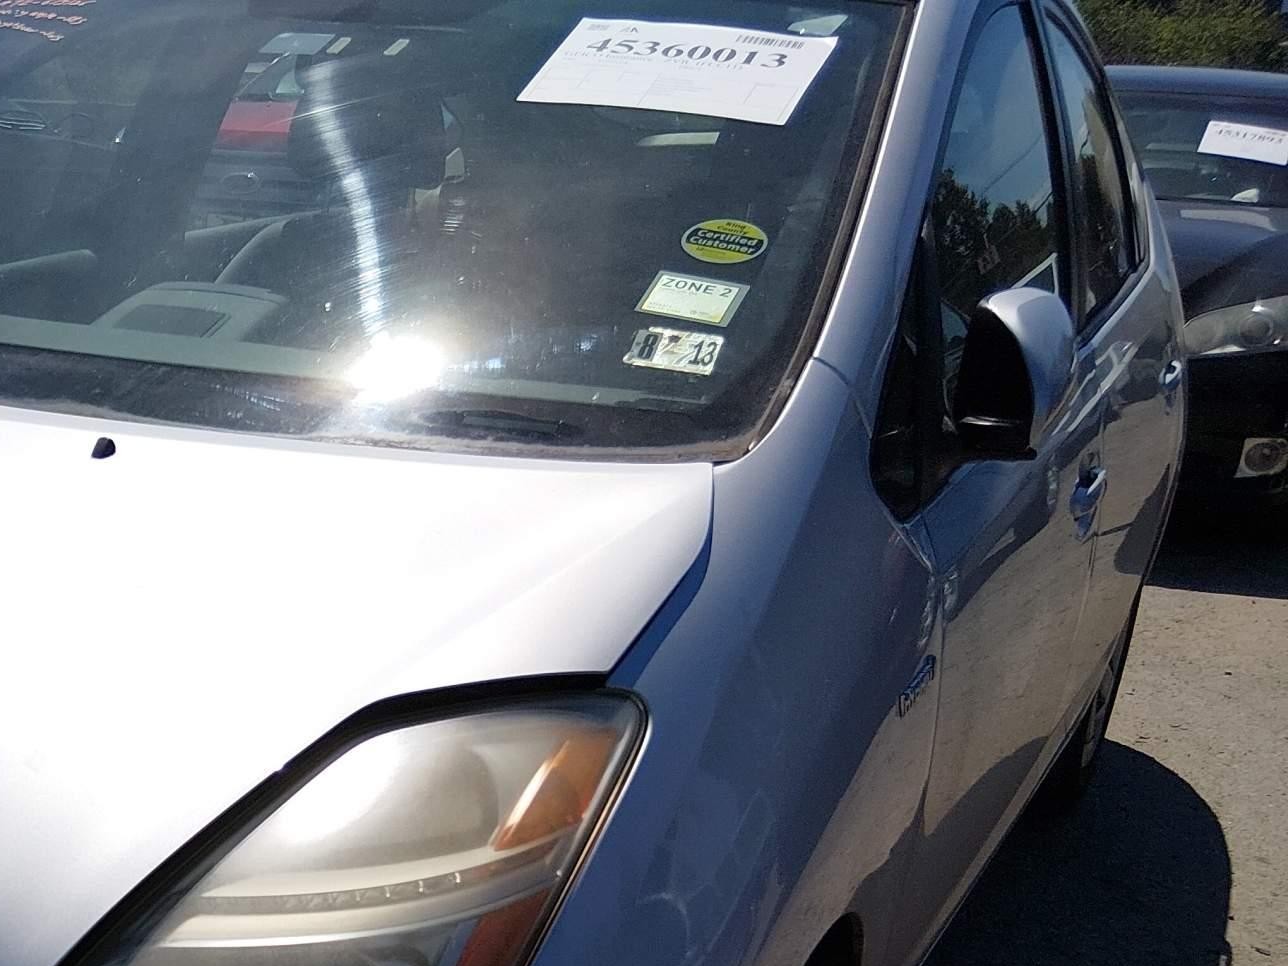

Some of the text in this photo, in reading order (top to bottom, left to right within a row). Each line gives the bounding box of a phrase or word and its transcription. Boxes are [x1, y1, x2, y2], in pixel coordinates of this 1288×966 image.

[586, 38, 787, 68] 45360013
[689, 236, 756, 254] Customer
[697, 229, 759, 246] Certified
[662, 277, 716, 294] ZONE
[720, 287, 733, 298] 2
[638, 333, 718, 366] 8 13
